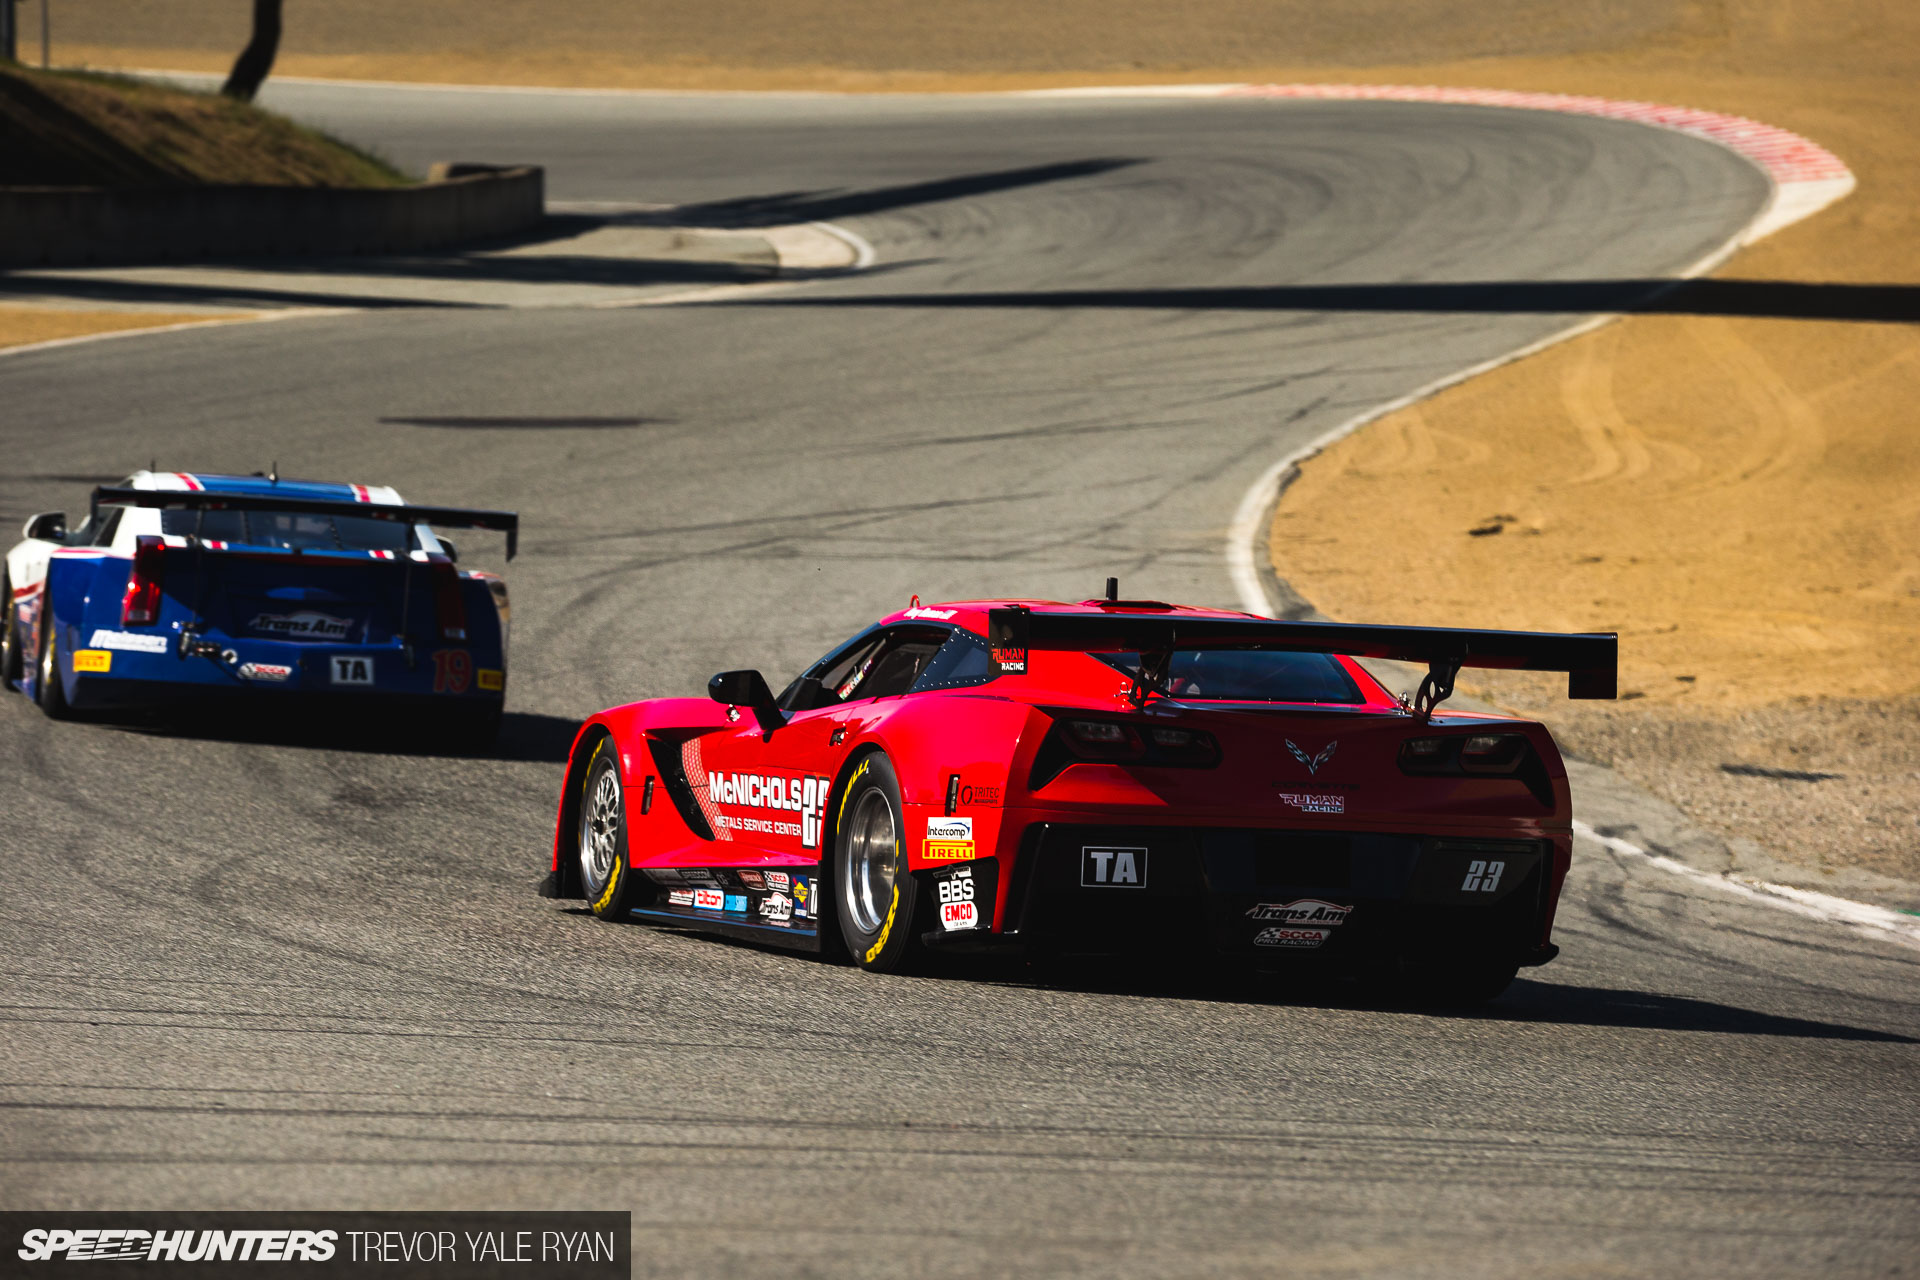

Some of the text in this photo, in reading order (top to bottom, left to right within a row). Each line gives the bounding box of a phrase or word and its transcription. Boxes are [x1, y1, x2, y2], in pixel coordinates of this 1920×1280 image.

[258, 615, 345, 633] Trans Am
[992, 648, 1025, 663] RUMAN
[336, 660, 368, 681] TA
[432, 649, 472, 693] 19
[1001, 662, 1025, 671] RACING
[708, 770, 802, 812] McNICHOLS
[974, 786, 1000, 799] TRITEC
[1279, 793, 1344, 806] RUMAN
[1302, 805, 1344, 814] RACING
[714, 815, 802, 837] METALS SERVICE CENTER
[927, 825, 966, 839] Intercomp
[924, 840, 973, 858] PIRELLI
[1090, 851, 1138, 883] TA
[1461, 860, 1505, 892] 23
[770, 874, 787, 883] SCCA
[938, 878, 975, 903] BBS
[945, 903, 972, 922] EMCO
[1253, 904, 1347, 921] Trans Am
[1278, 930, 1324, 940] SCCA
